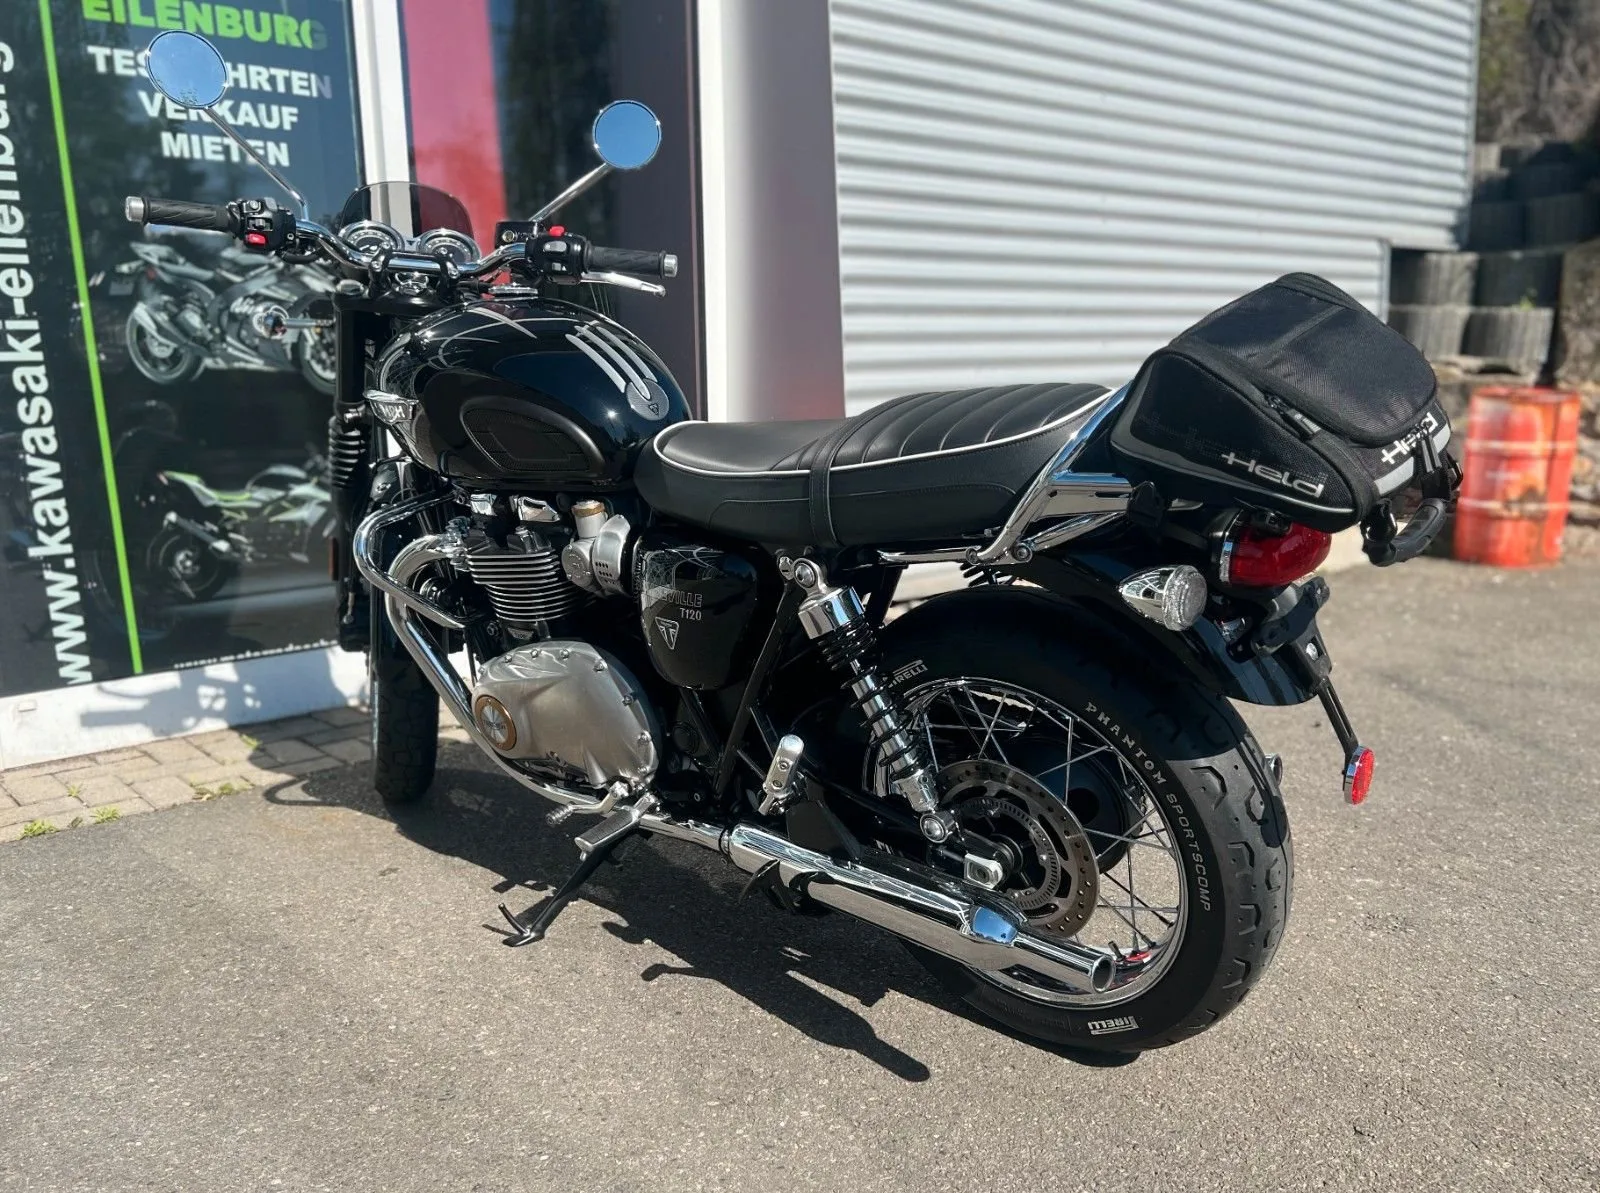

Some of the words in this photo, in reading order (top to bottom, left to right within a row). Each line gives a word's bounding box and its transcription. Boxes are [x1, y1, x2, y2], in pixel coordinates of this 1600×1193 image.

[82, 0, 328, 50] EILENBURG
[86, 45, 333, 99] TEHRTEN
[0, 42, 93, 685] www.kawasaki-eilen
[1381, 411, 1439, 465] Hed
[1221, 451, 1325, 498] Held
[679, 607, 702, 621] T120
[1085, 702, 1168, 785] PHANTOM
[1165, 792, 1211, 913] SPORTSCOMP
[1087, 1015, 1139, 1035] PIRELLI
